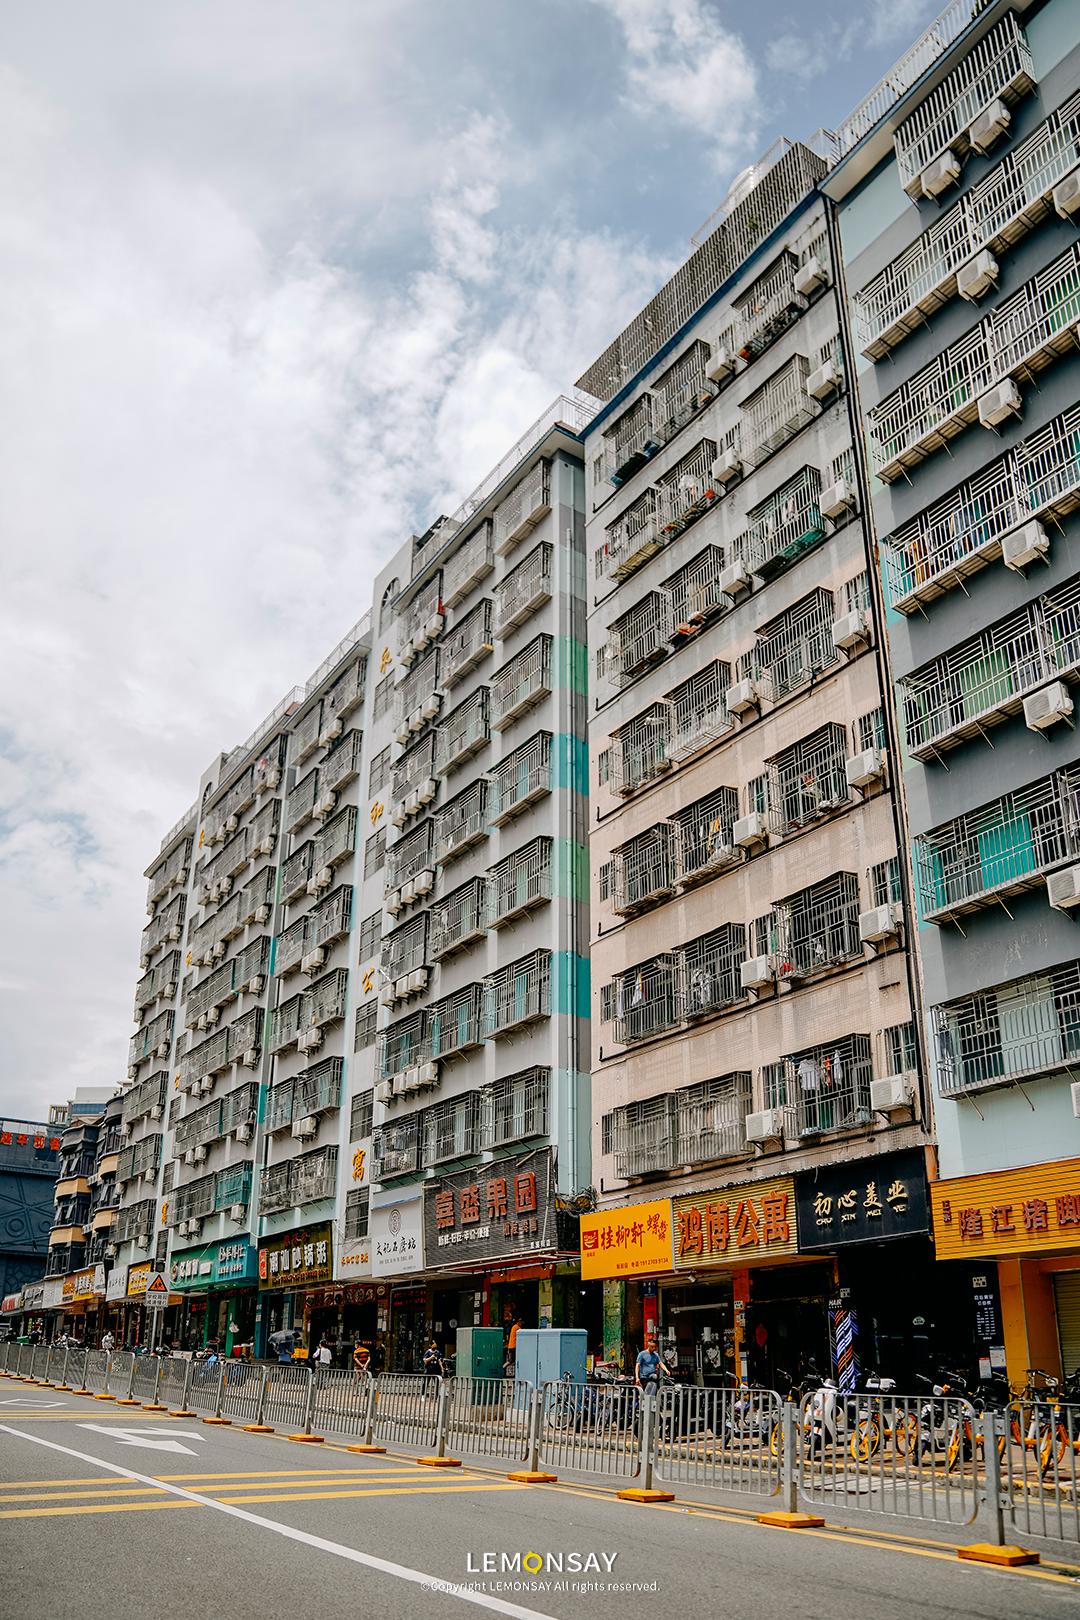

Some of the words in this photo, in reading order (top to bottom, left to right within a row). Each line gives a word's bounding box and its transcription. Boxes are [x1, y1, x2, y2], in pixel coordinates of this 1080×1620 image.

[435, 1171, 538, 1229] 嘉盛果园
[812, 1180, 909, 1216] 初心美业
[841, 1213, 856, 1223] XIN
[866, 1208, 882, 1218] MEI
[600, 1221, 645, 1251] 桂柳轩
[677, 1190, 790, 1257] 鸿博公寓
